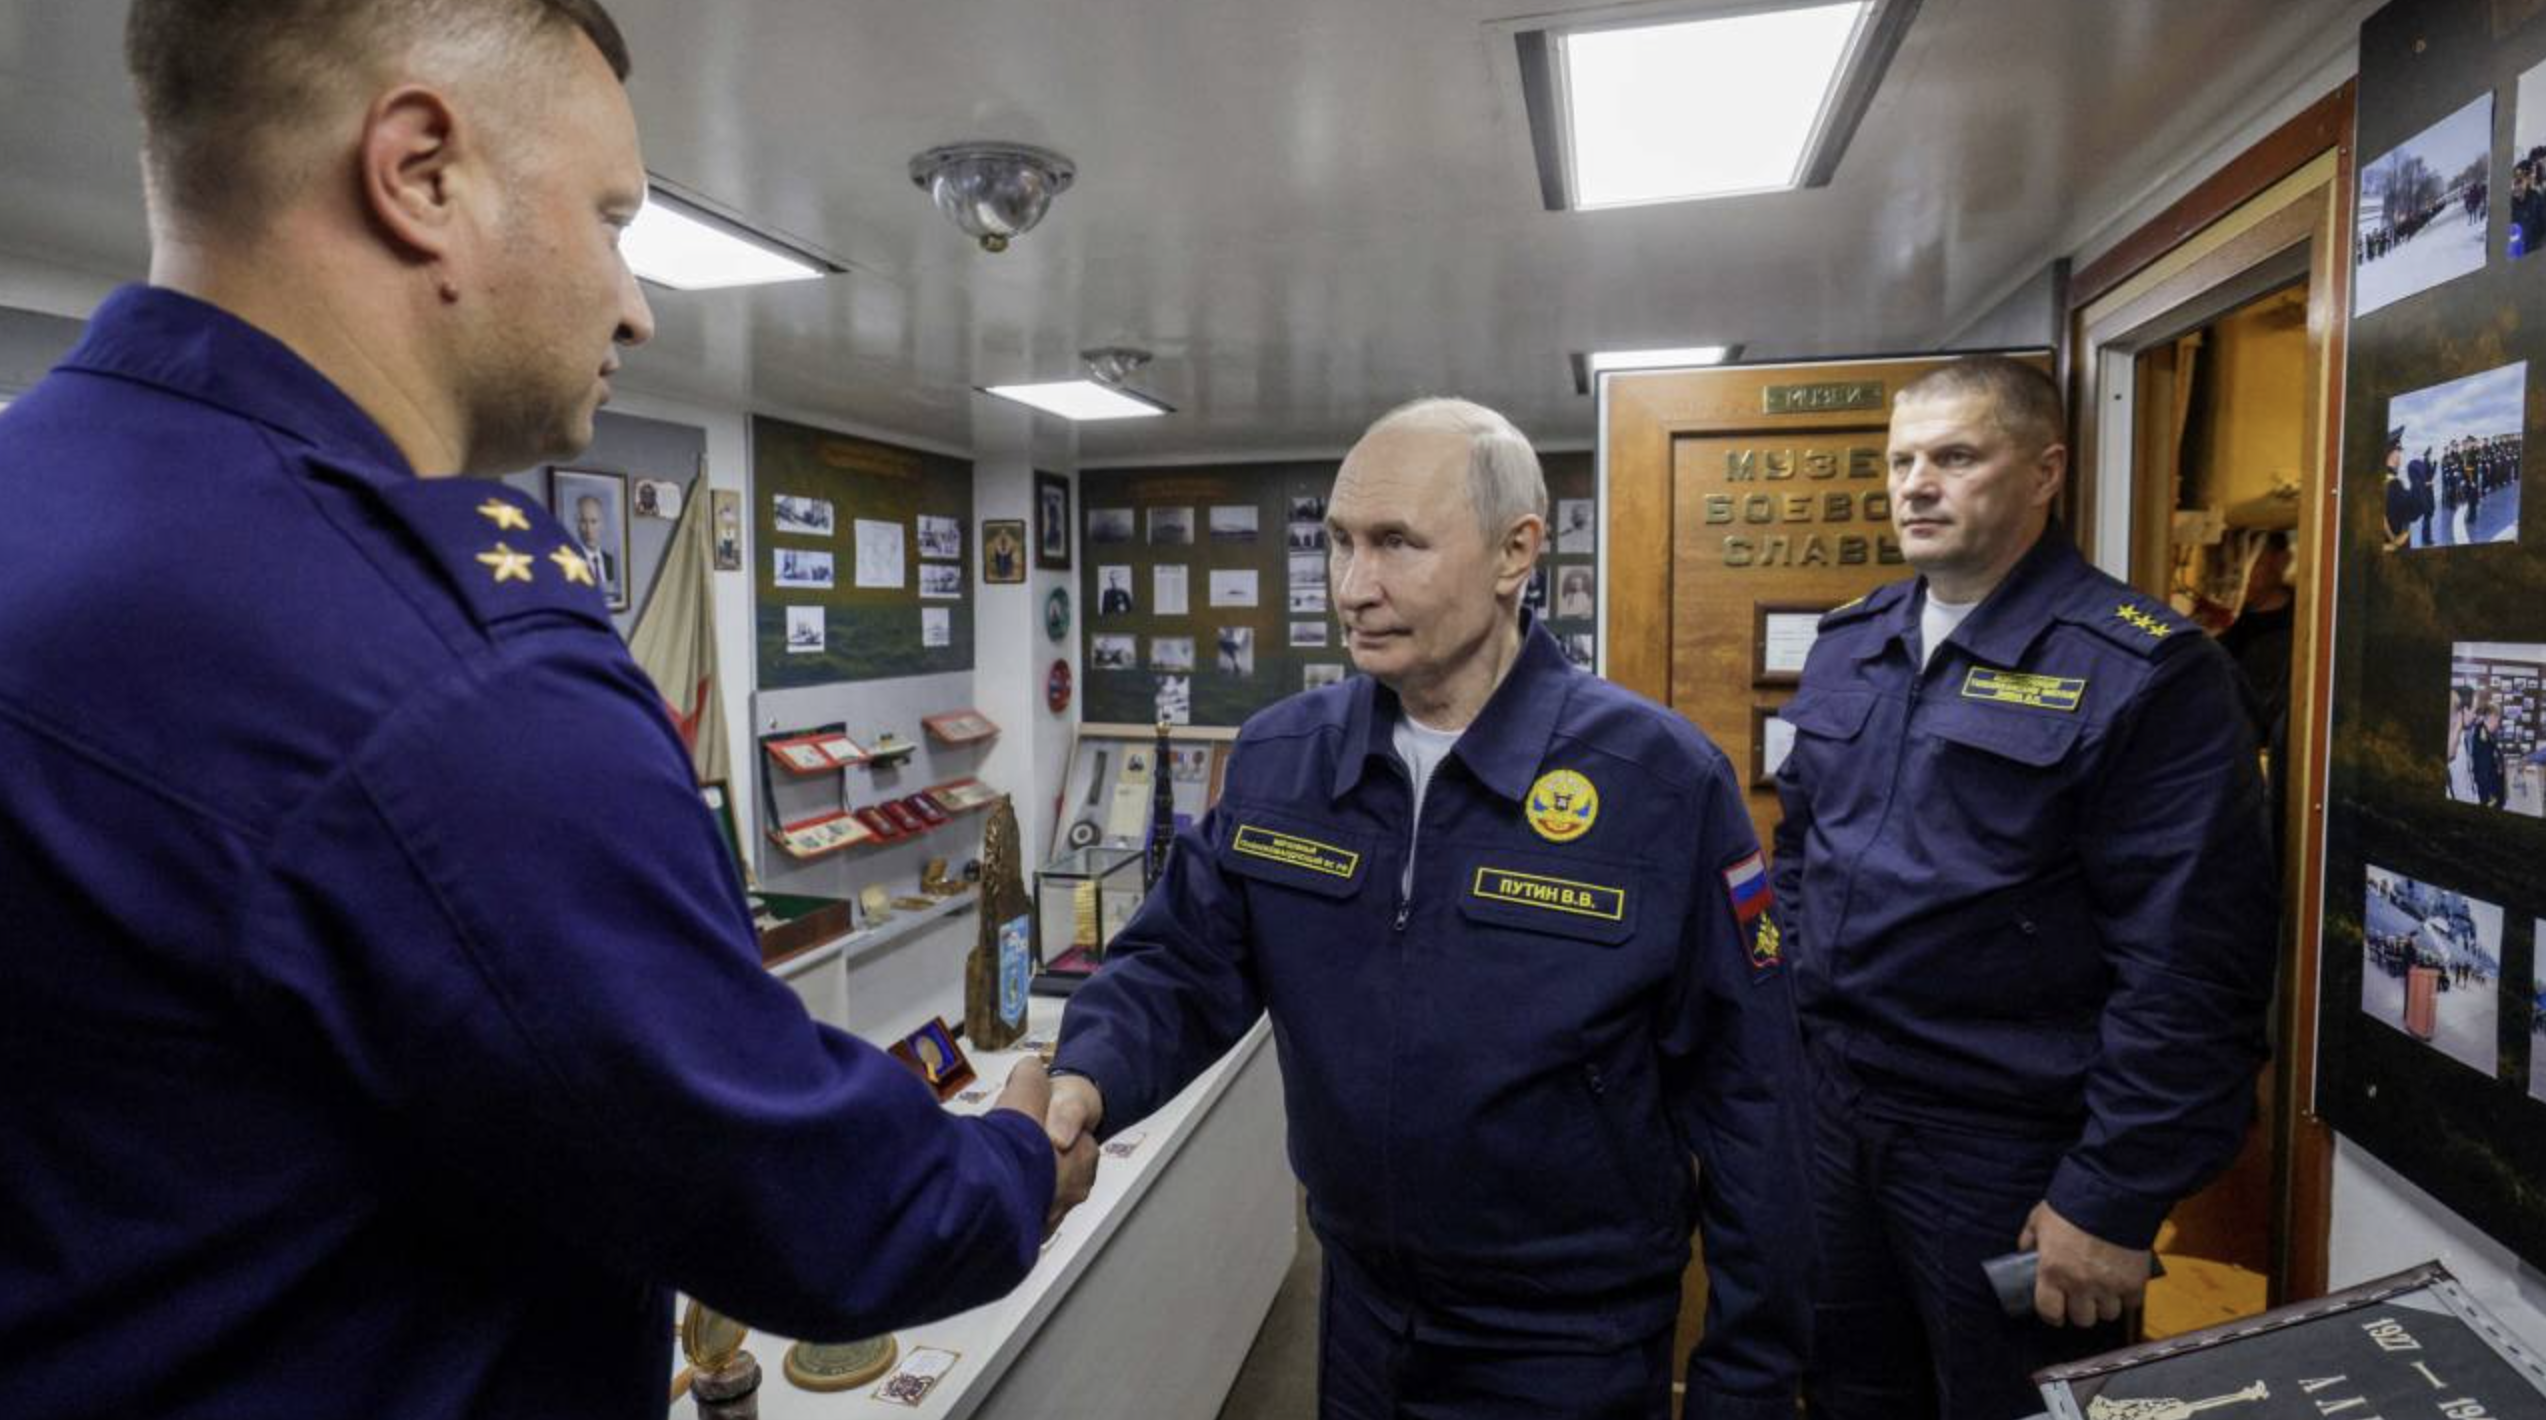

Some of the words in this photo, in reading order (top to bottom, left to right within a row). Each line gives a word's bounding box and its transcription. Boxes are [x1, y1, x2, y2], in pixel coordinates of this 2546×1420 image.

[1726, 448, 1881, 482] МУЗЕ
[1704, 490, 1892, 525] БОЕВО
[1500, 878, 1559, 902] ПУТИН
[1560, 888, 1596, 909] В.В.
